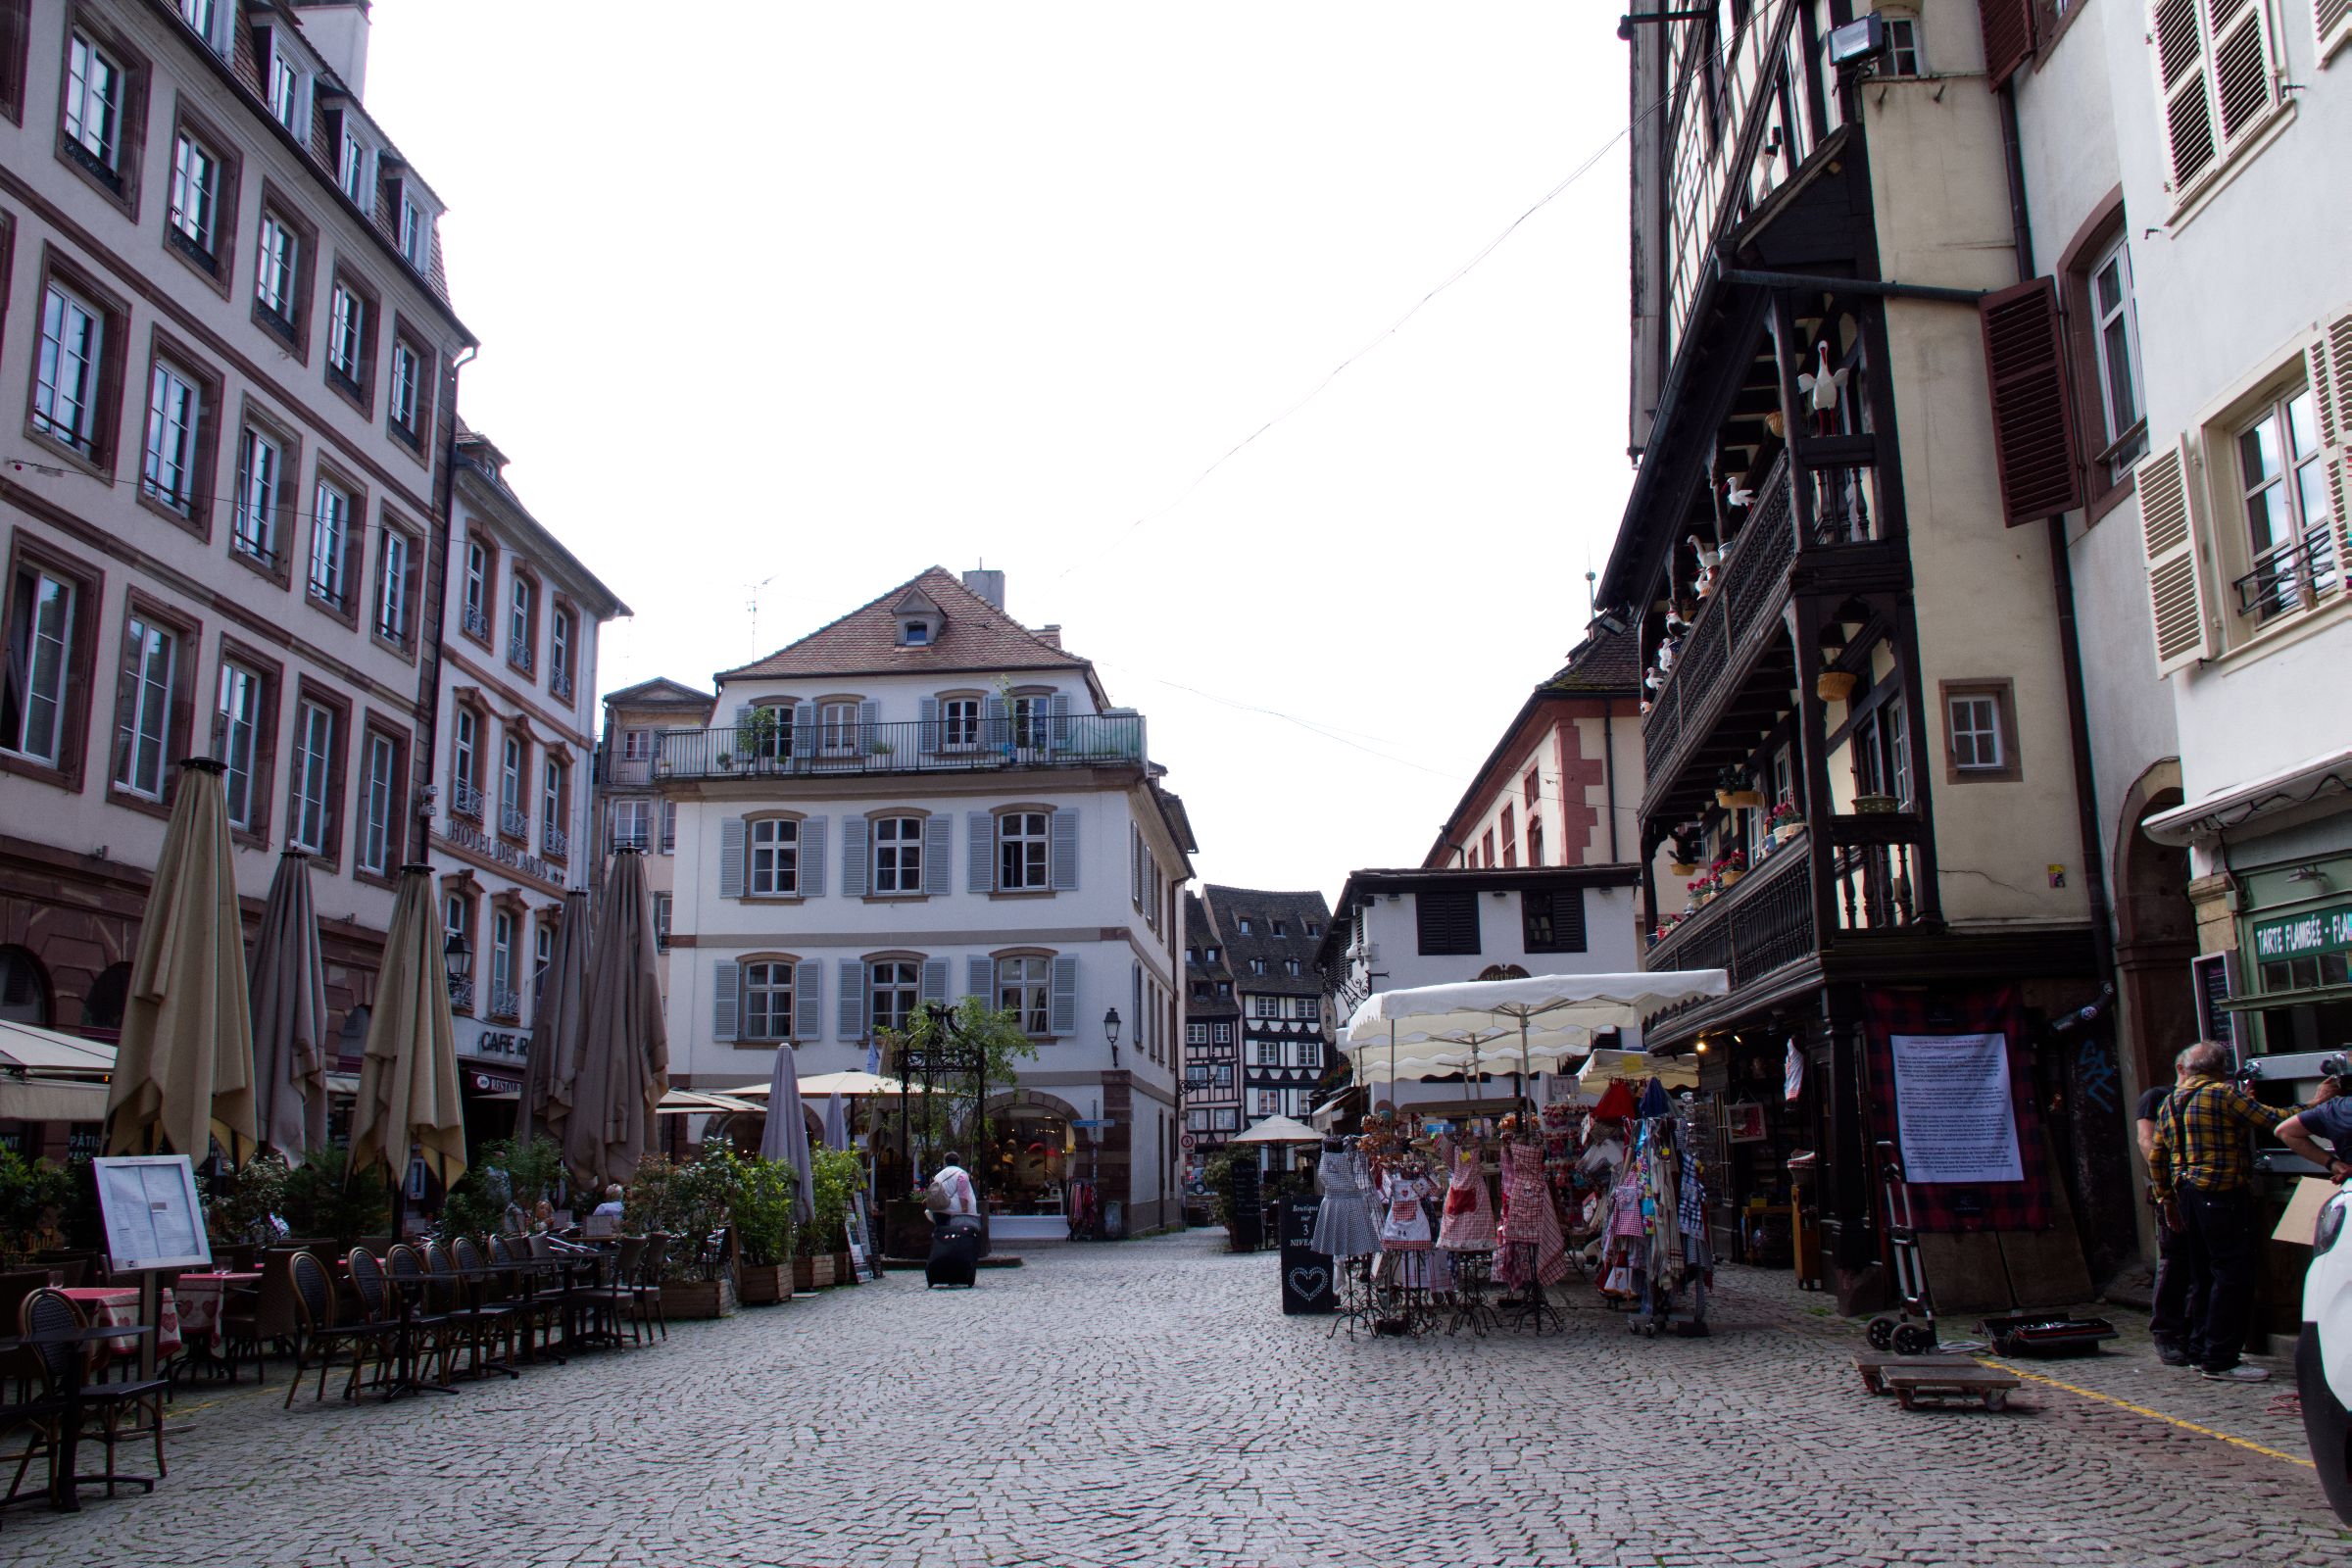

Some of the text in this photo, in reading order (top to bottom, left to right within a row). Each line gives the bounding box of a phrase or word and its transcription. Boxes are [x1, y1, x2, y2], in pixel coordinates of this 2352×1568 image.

[450, 820, 548, 879] HÔTEL DES ARTS
[2257, 911, 2352, 956] TARTE FLAMBÉE FLA
[481, 1032, 515, 1054] CAFE
[491, 1078, 522, 1093] RESTAUR
[1293, 1204, 1319, 1214] Boutique
[1302, 1224, 1309, 1236] 3
[1290, 1238, 1314, 1248] NIVEA
